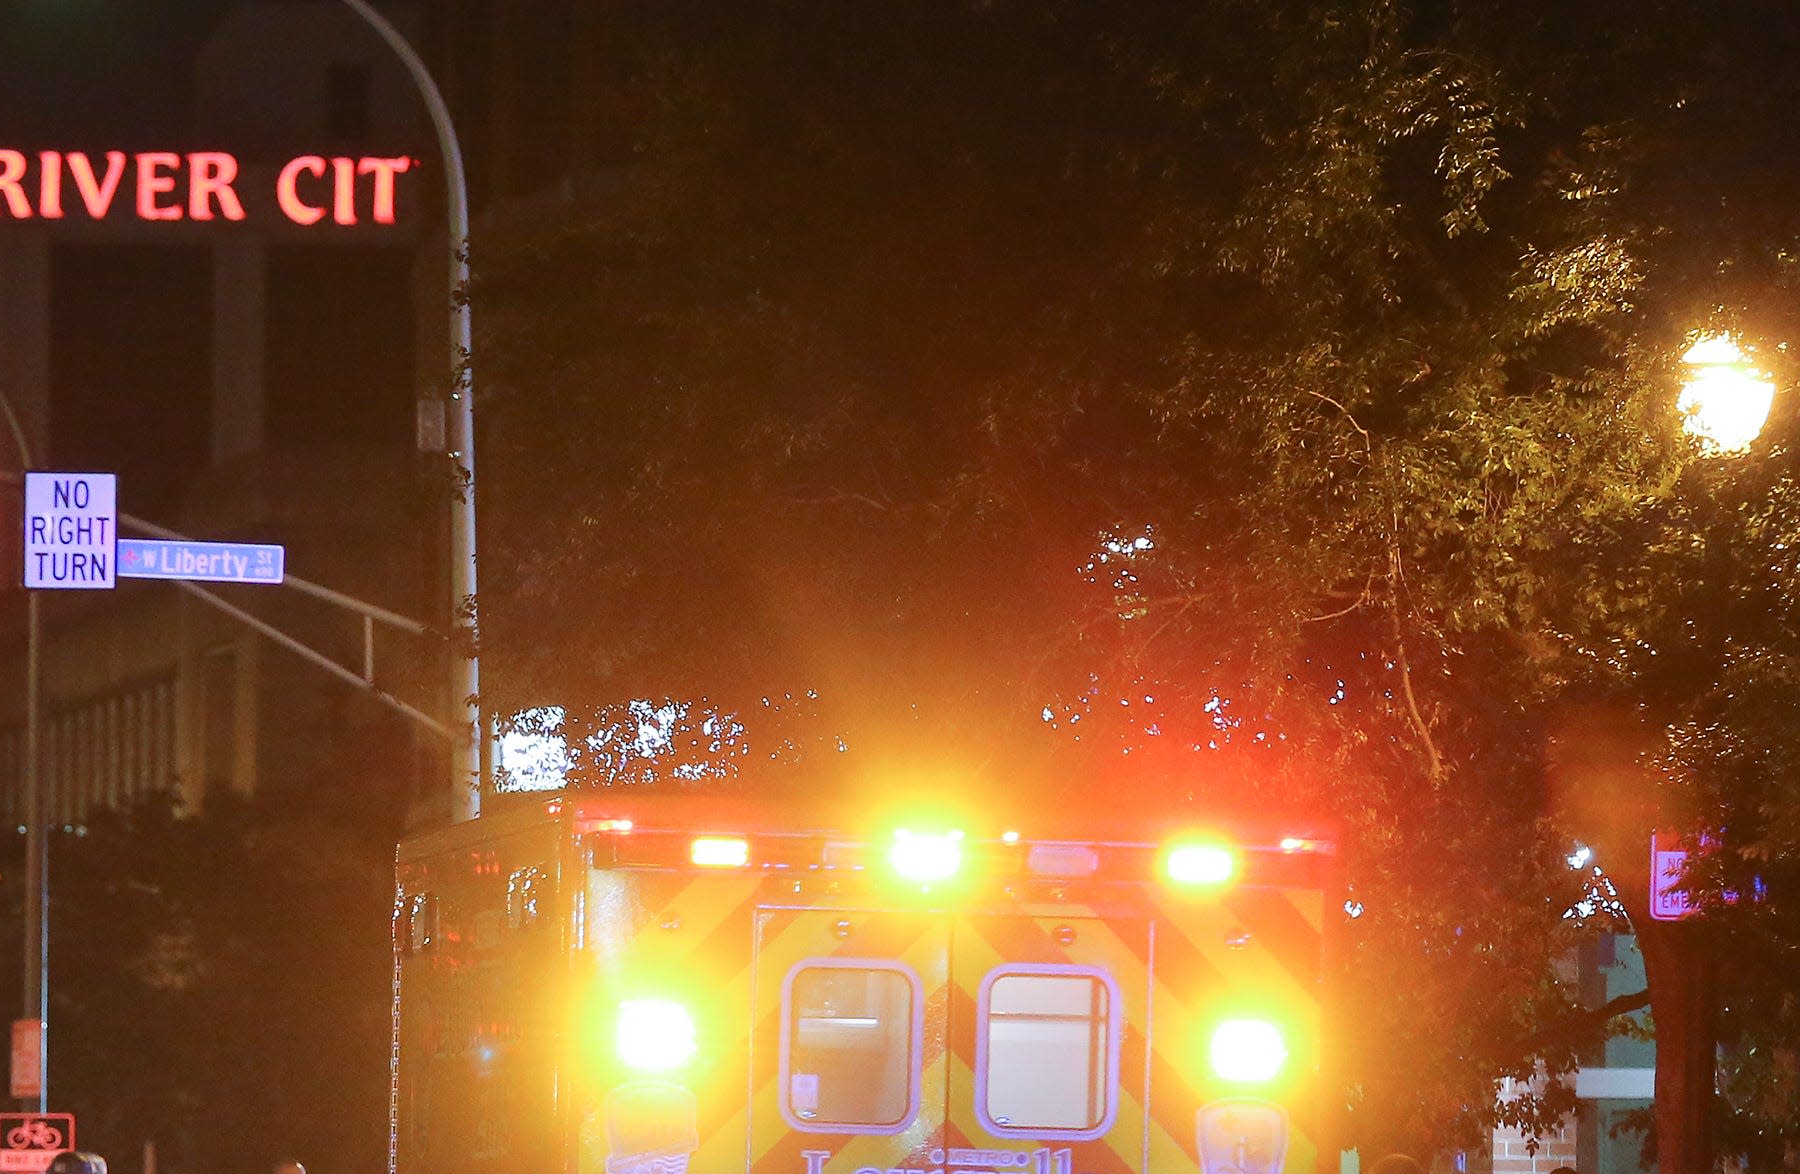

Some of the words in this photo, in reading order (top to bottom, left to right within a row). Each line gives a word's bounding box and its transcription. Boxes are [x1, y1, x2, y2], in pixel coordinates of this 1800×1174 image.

[276, 155, 421, 225] CIT
[53, 479, 90, 509] NO
[31, 516, 110, 545] RIGHT
[34, 552, 106, 582] TURN
[142, 549, 158, 569] W
[161, 546, 249, 578] Liberty
[255, 550, 274, 565] St
